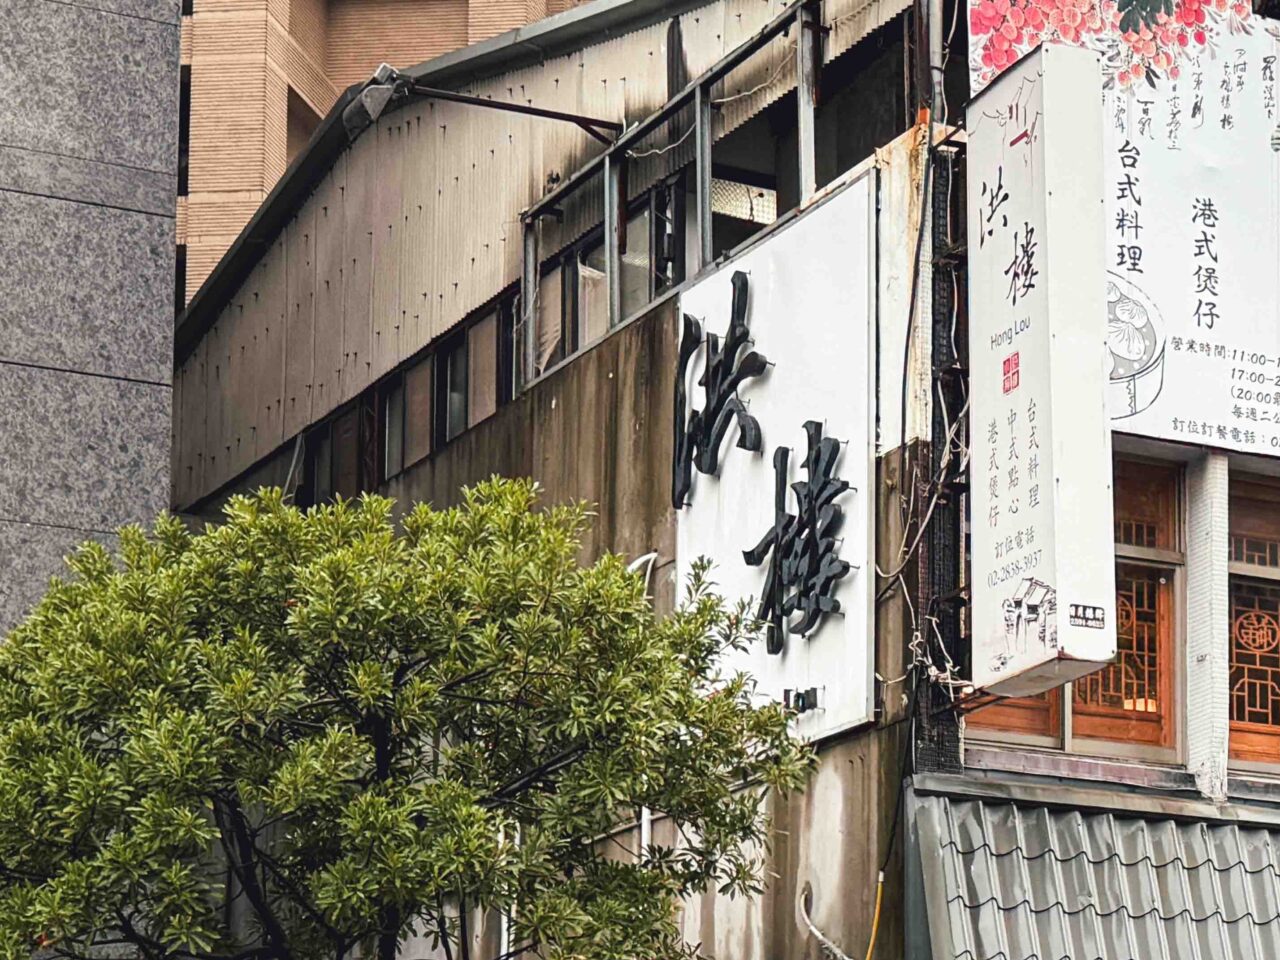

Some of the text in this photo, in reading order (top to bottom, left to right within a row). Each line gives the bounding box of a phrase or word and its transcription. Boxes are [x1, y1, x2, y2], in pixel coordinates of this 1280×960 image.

[1115, 138, 1143, 274] 台式料理
[1191, 197, 1221, 330] 港式煲仔
[990, 314, 1032, 350] Hong Lou
[1006, 408, 1019, 515] 中式點心
[1027, 397, 1040, 509] 台式料理
